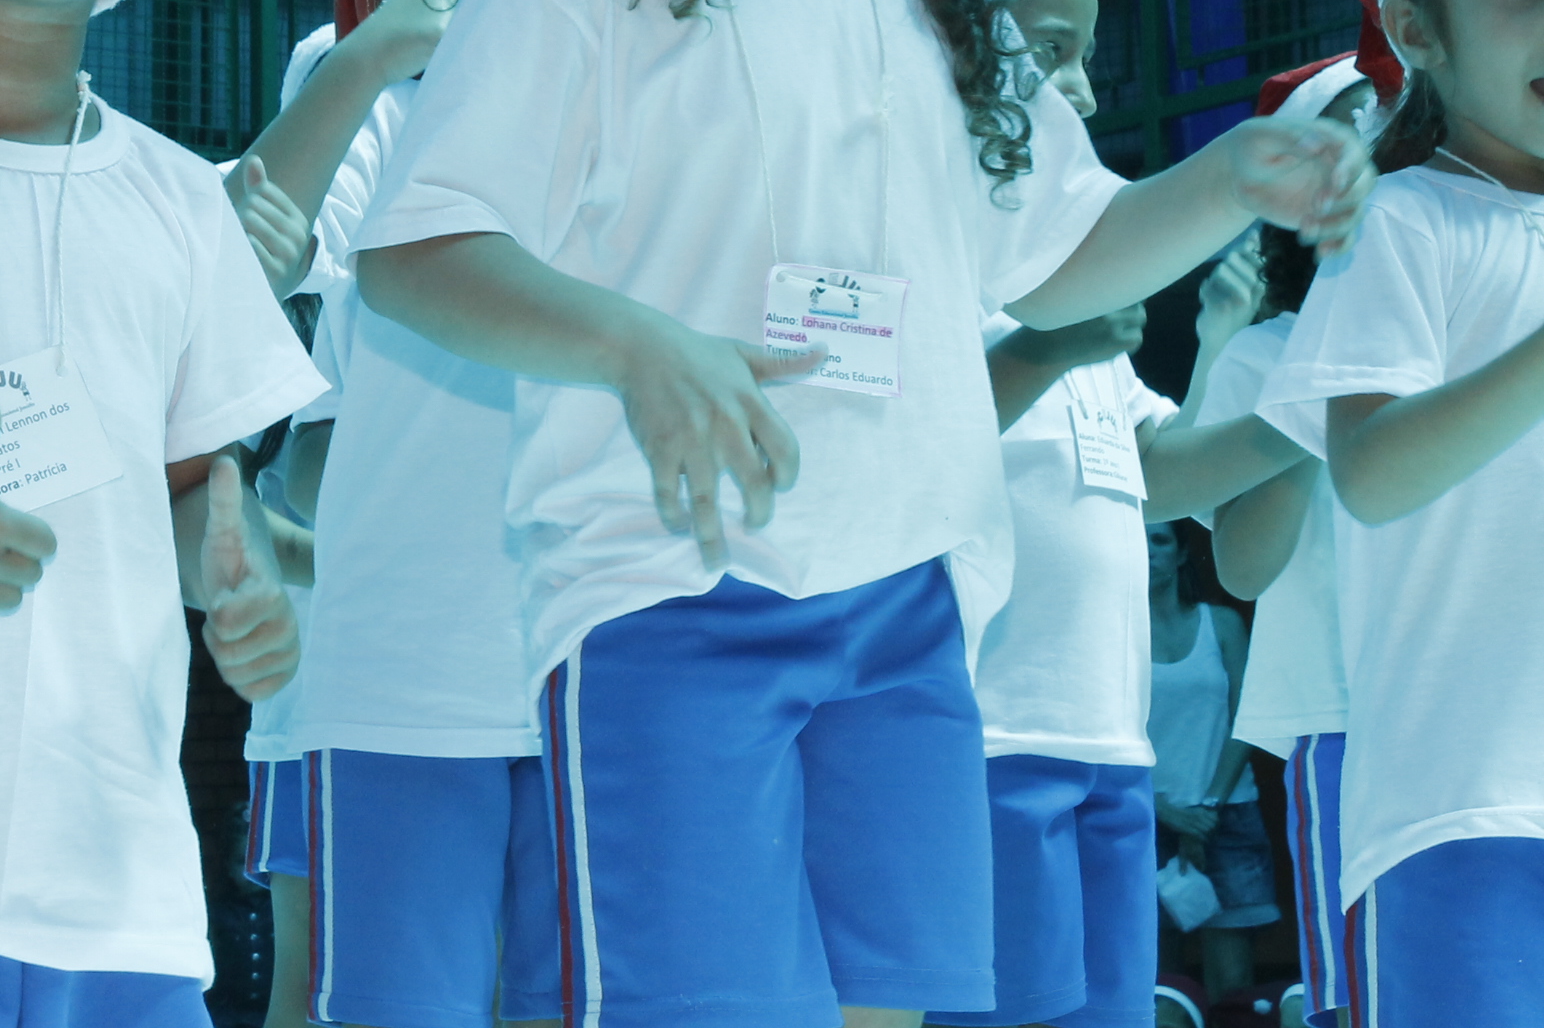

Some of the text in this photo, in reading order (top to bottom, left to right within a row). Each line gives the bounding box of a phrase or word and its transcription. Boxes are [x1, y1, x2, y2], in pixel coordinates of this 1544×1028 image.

[765, 312, 799, 326] Aluno:
[801, 315, 838, 331] Lohana
[839, 321, 877, 336] Cristina
[879, 326, 893, 338] de
[819, 367, 850, 381] Carlos
[852, 371, 894, 386] Eduardo
[5, 408, 48, 433] Lennon
[49, 400, 71, 417] dos
[24, 461, 68, 485] Patrícia
